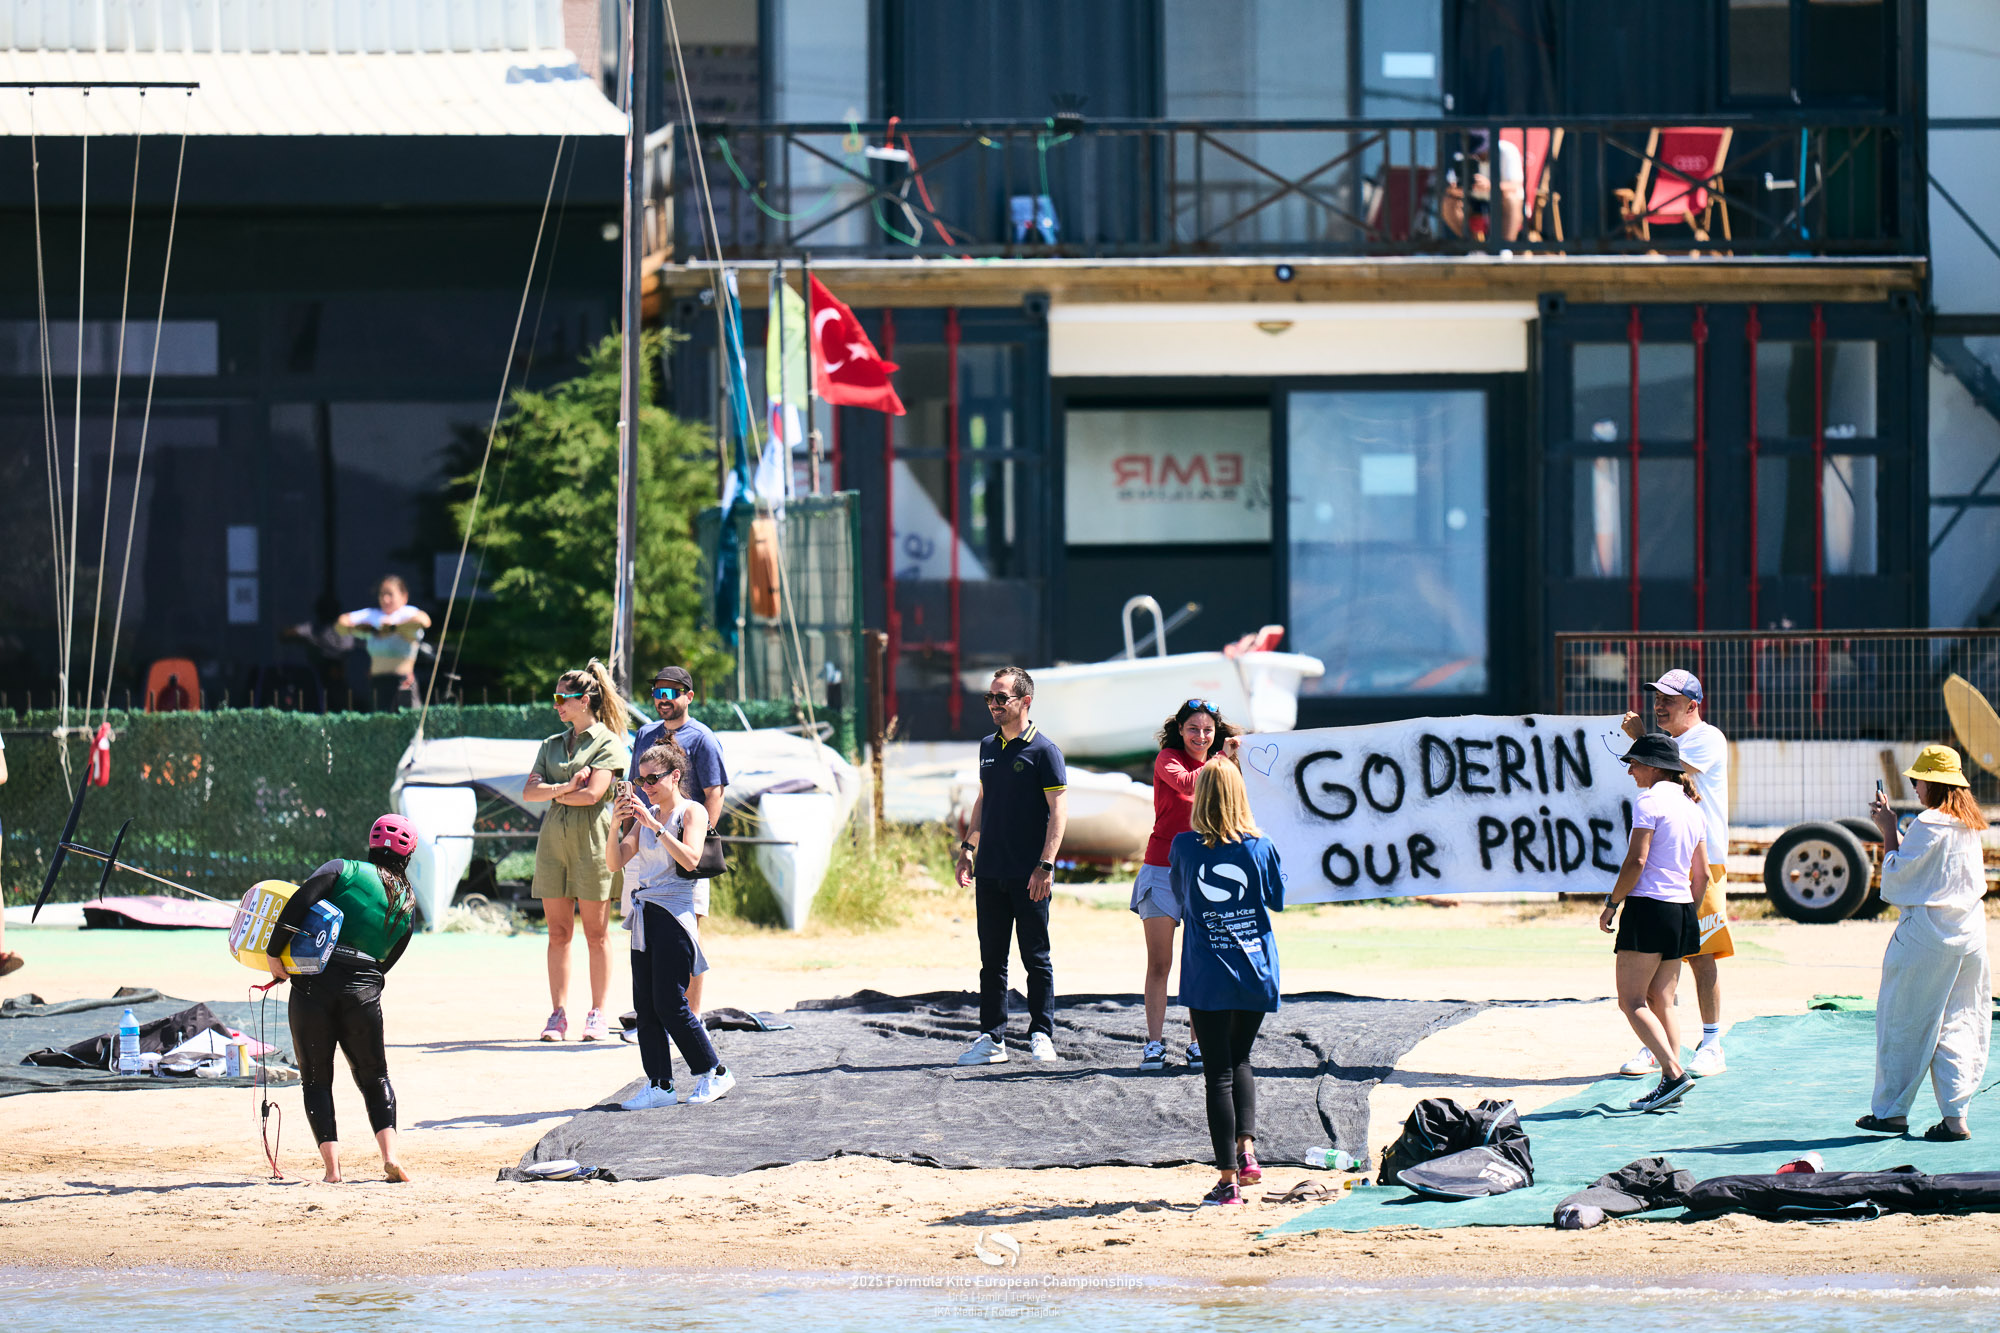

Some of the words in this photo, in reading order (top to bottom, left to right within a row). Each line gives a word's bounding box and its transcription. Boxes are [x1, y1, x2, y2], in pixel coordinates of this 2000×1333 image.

[1293, 750, 1405, 820] GO
[1321, 832, 1441, 886] OUR
[240, 900, 257, 936] TUR
[1236, 908, 1256, 917] Kite
